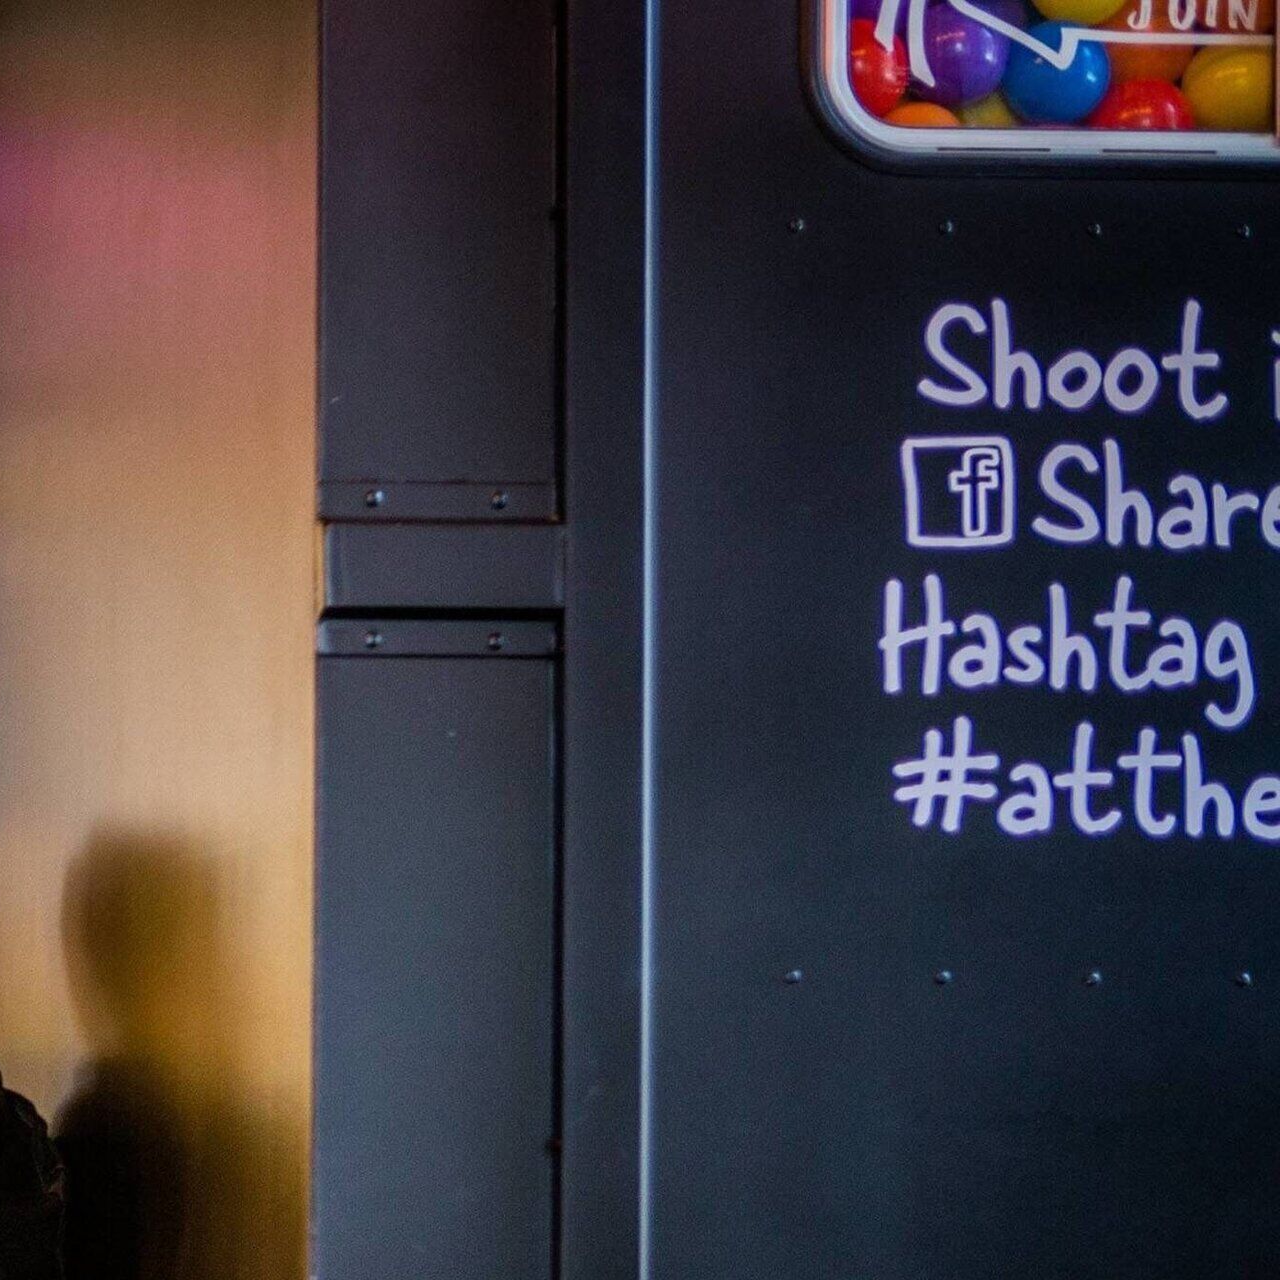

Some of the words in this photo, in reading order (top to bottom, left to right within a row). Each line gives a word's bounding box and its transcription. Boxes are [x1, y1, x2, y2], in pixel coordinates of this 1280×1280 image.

[917, 298, 1228, 420] Shoot
[1032, 438, 1280, 550] Share
[879, 573, 1255, 729] Hashtag
